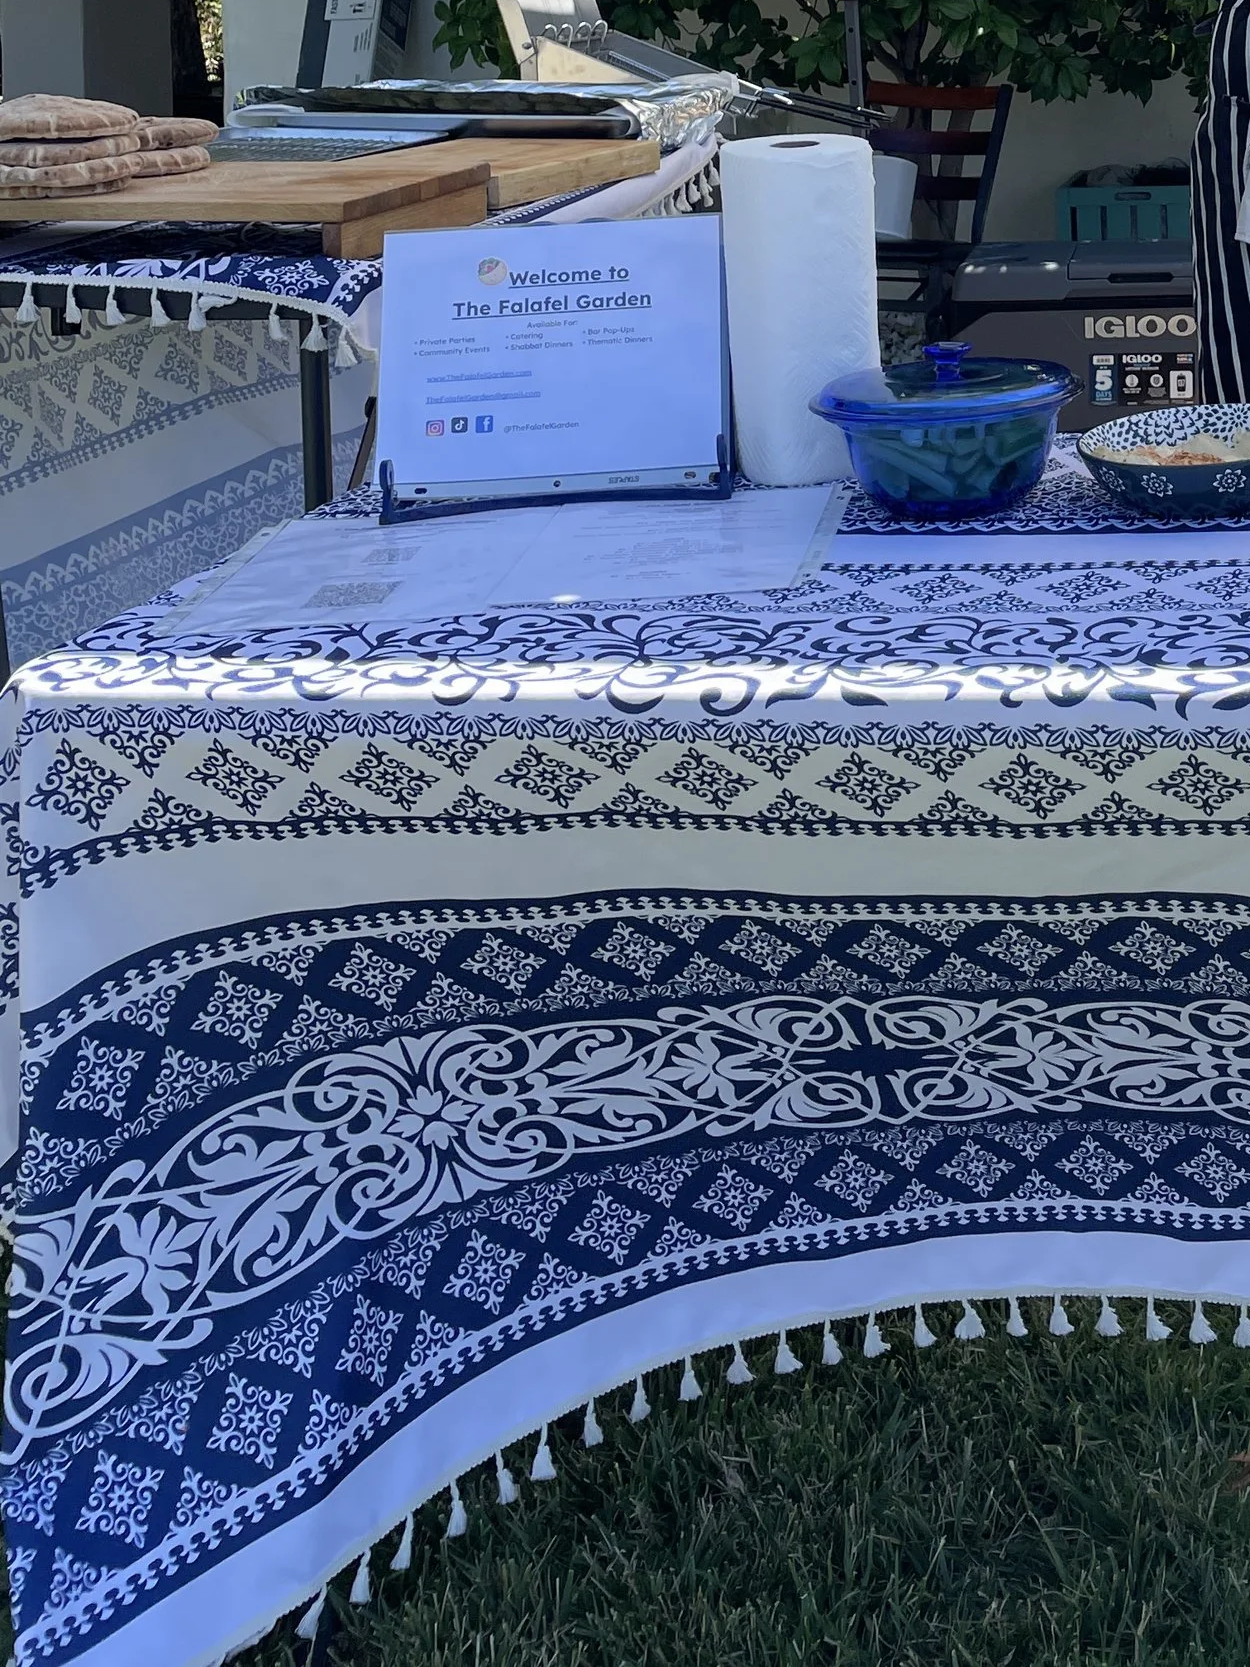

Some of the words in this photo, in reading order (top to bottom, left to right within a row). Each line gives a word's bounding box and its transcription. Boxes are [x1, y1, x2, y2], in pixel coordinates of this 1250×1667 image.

[509, 267, 601, 286] Welcome
[608, 265, 629, 281] to
[453, 301, 490, 317] The
[500, 295, 568, 315] Falafel
[576, 292, 651, 310] Garden
[527, 320, 561, 329] Available
[1084, 315, 1197, 339] IGLOO
[587, 327, 601, 336] Bar
[603, 326, 635, 336] Pop-Ups
[419, 337, 447, 346] Private
[449, 336, 475, 345] Parties
[510, 332, 543, 342] Catering
[588, 337, 621, 346] Thematic
[624, 335, 653, 344] Dinners
[419, 347, 463, 357] Community
[465, 345, 490, 354] Events
[510, 343, 542, 352] Shabbat
[545, 341, 573, 350] Dinners
[1122, 354, 1162, 363] IGLOO
[1095, 370, 1113, 391] 5
[504, 421, 579, 433] @TheFalafelGarden
